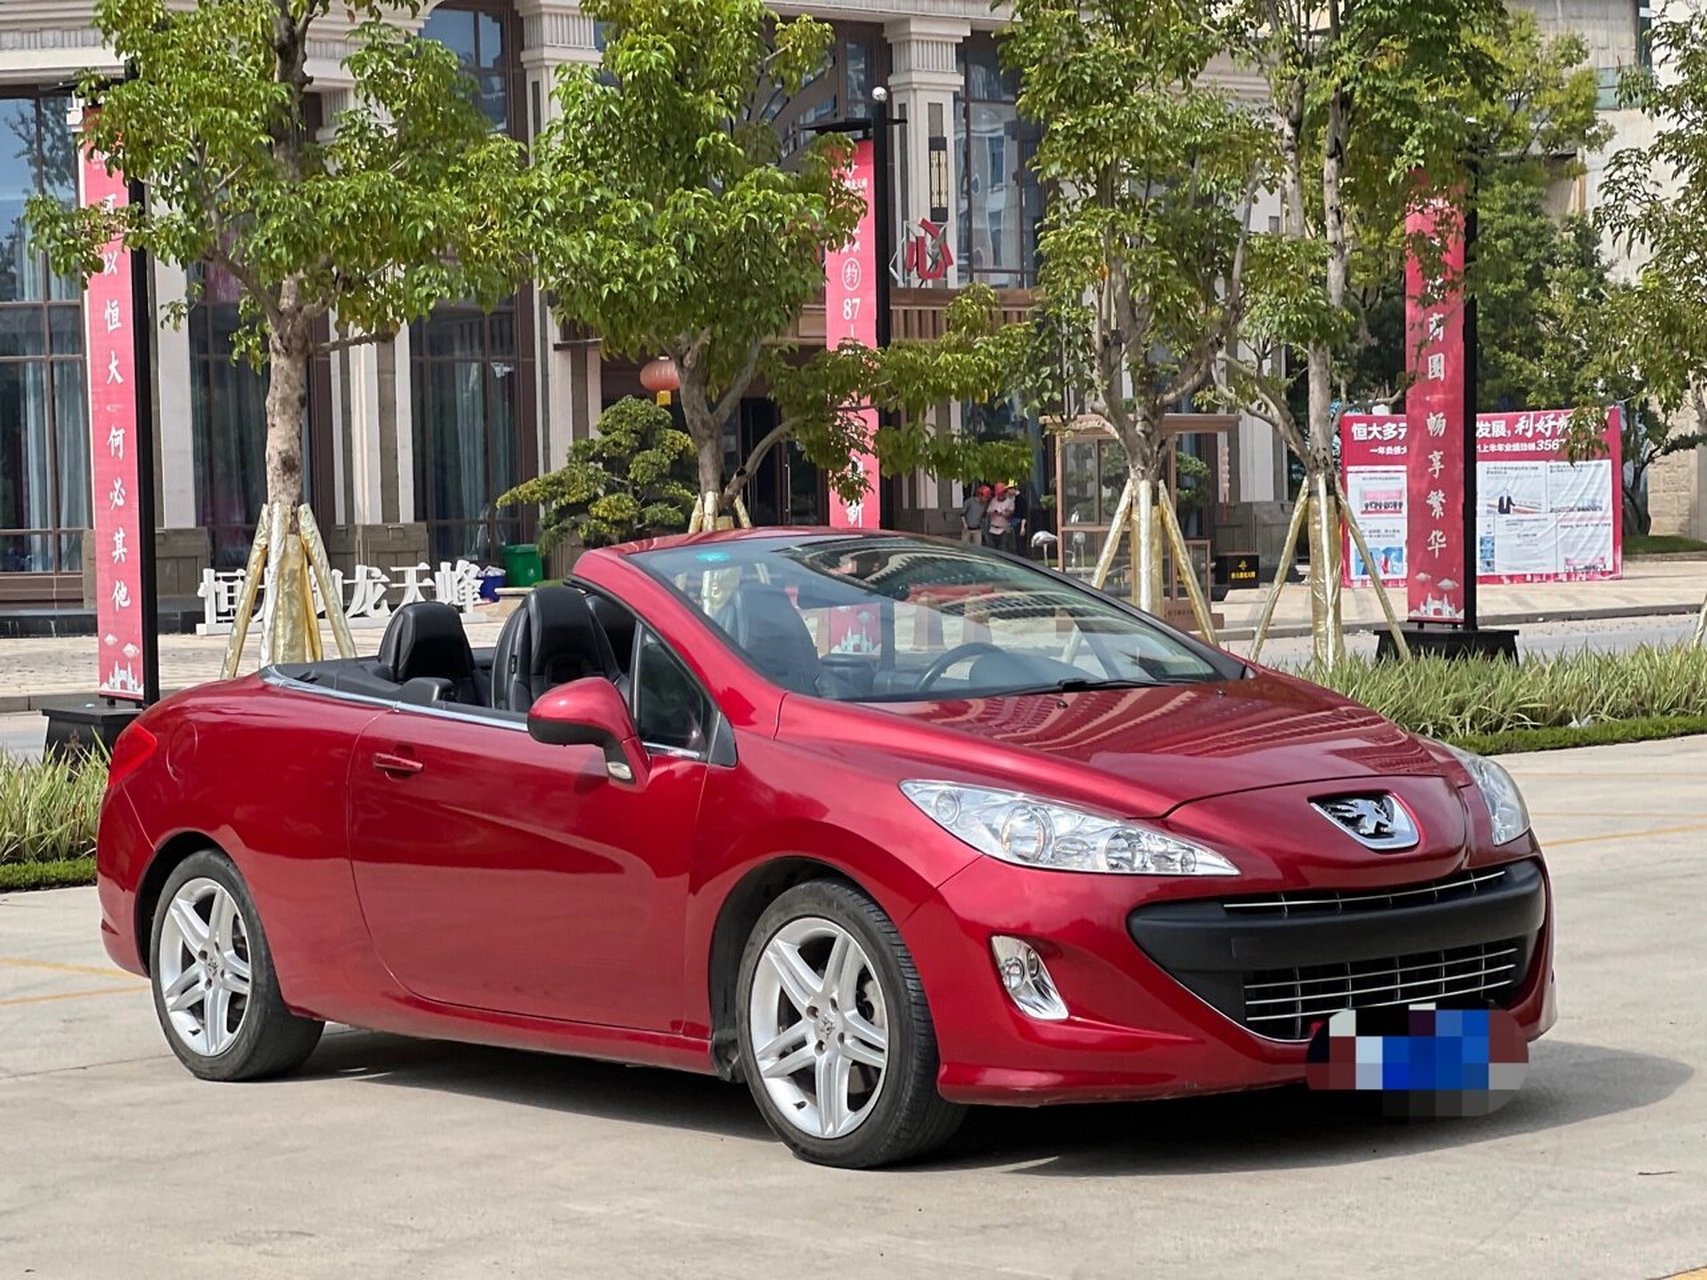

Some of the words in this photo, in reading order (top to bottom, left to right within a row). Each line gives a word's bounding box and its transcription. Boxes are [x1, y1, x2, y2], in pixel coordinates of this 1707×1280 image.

[843, 298, 861, 321] 87
[107, 425, 131, 613] 何必其他
[1425, 412, 1447, 559] 畅享繁华
